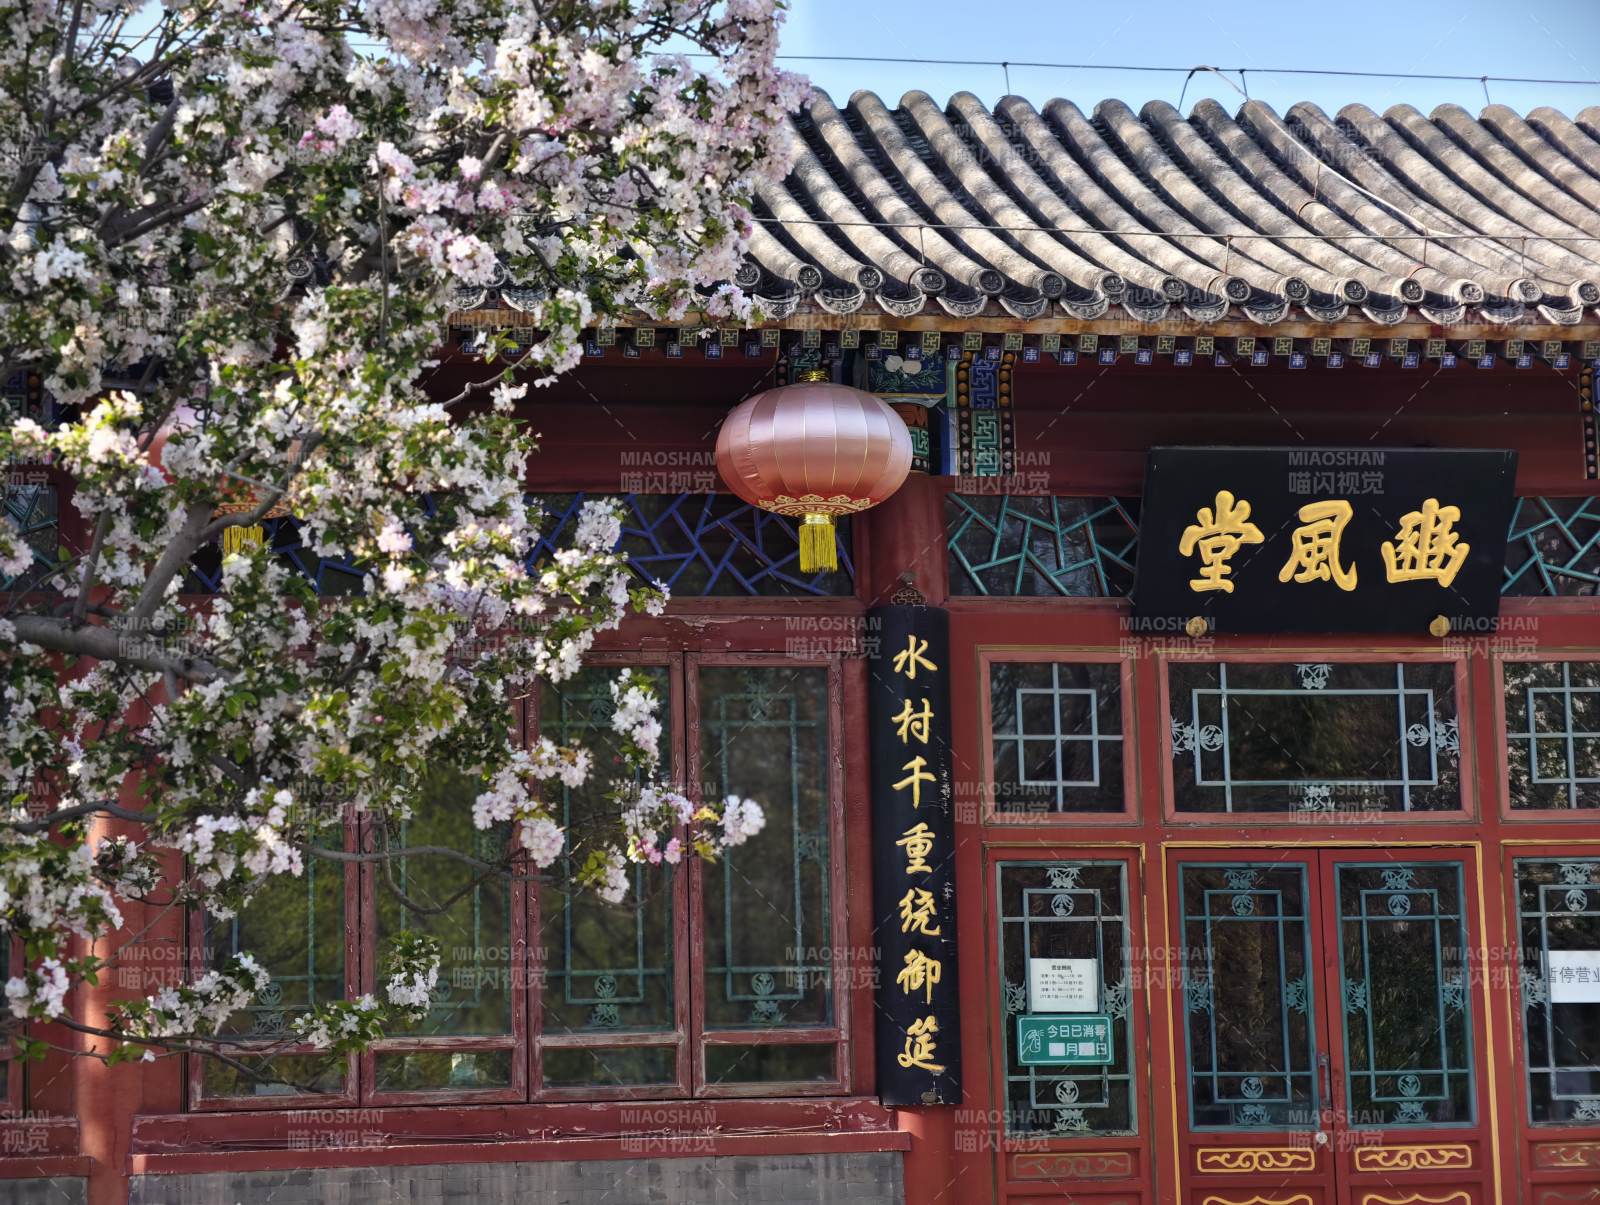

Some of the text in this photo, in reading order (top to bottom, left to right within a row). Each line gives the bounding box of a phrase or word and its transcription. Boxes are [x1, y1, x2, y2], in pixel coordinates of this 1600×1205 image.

[1048, 1024, 1106, 1038] 今日已消毒
